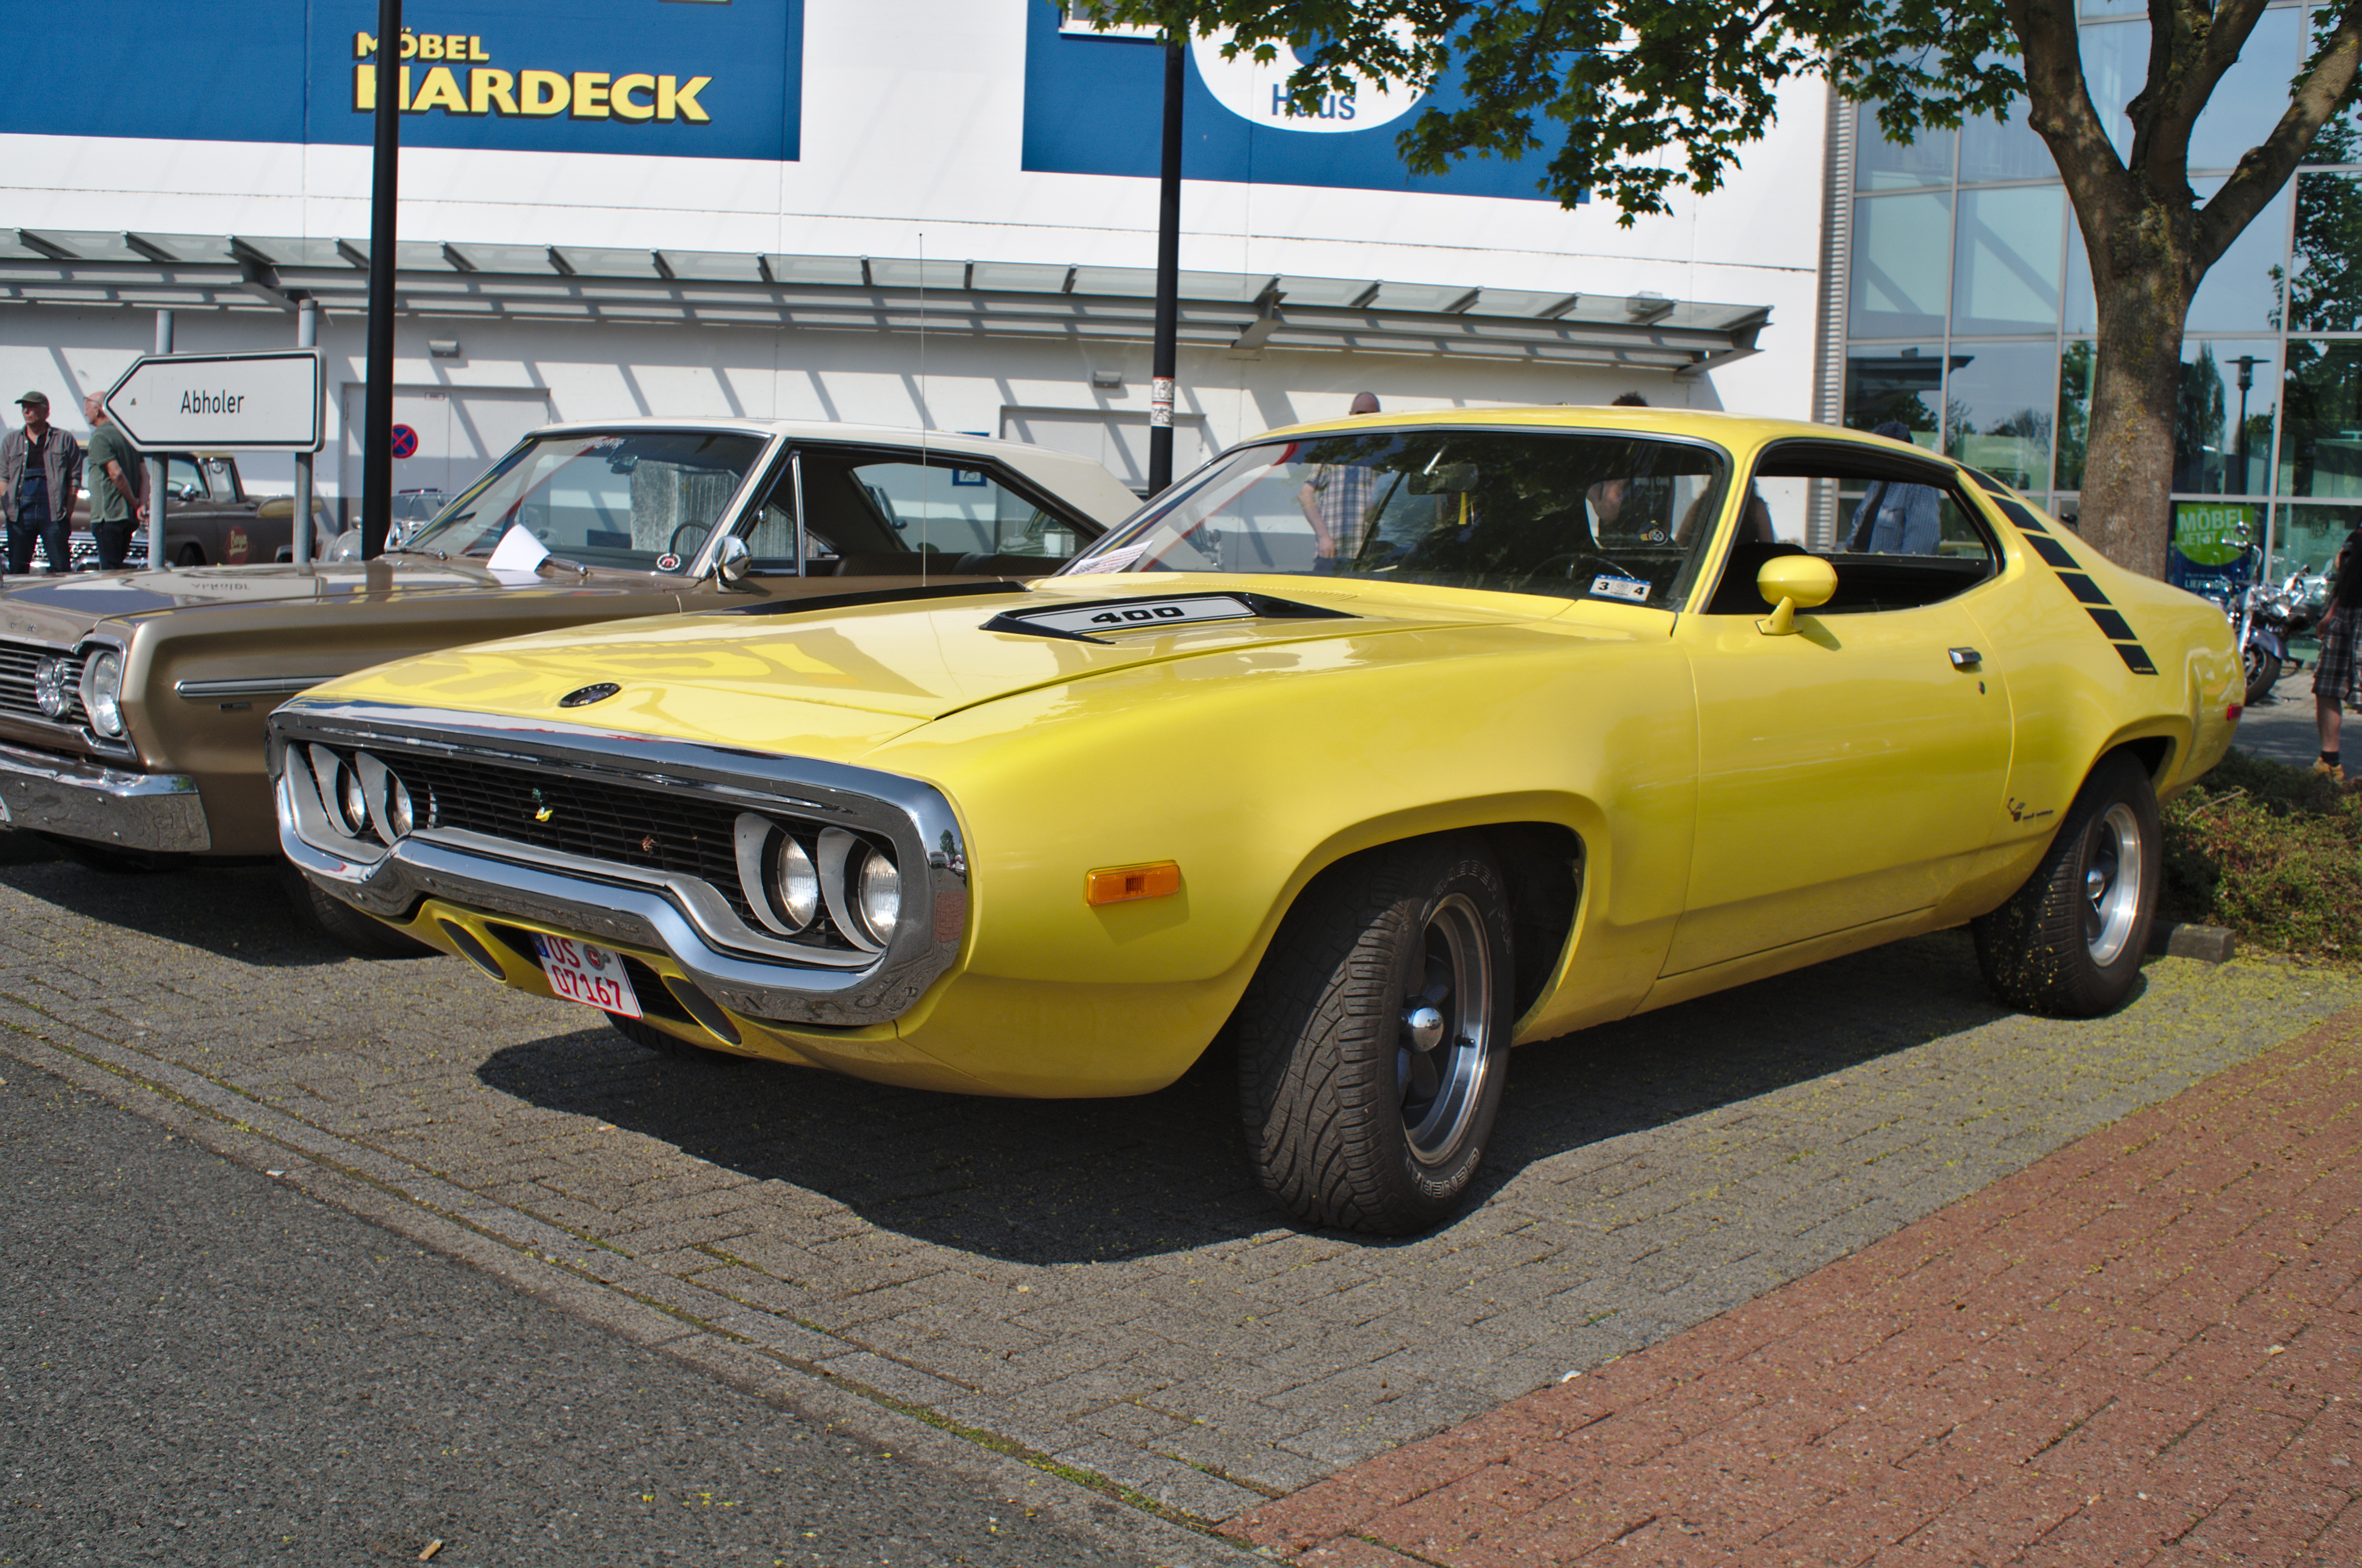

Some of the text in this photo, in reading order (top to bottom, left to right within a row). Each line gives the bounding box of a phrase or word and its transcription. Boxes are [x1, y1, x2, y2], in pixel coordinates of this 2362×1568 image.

[354, 27, 490, 63] MÖBEL
[353, 64, 713, 124] HARDECK
[180, 389, 245, 413] Abholer
[1598, 581, 1610, 591] 3
[1633, 587, 1645, 596] 4
[1090, 607, 1185, 623] 400
[547, 935, 581, 969] OS
[551, 964, 622, 1010] 07167
